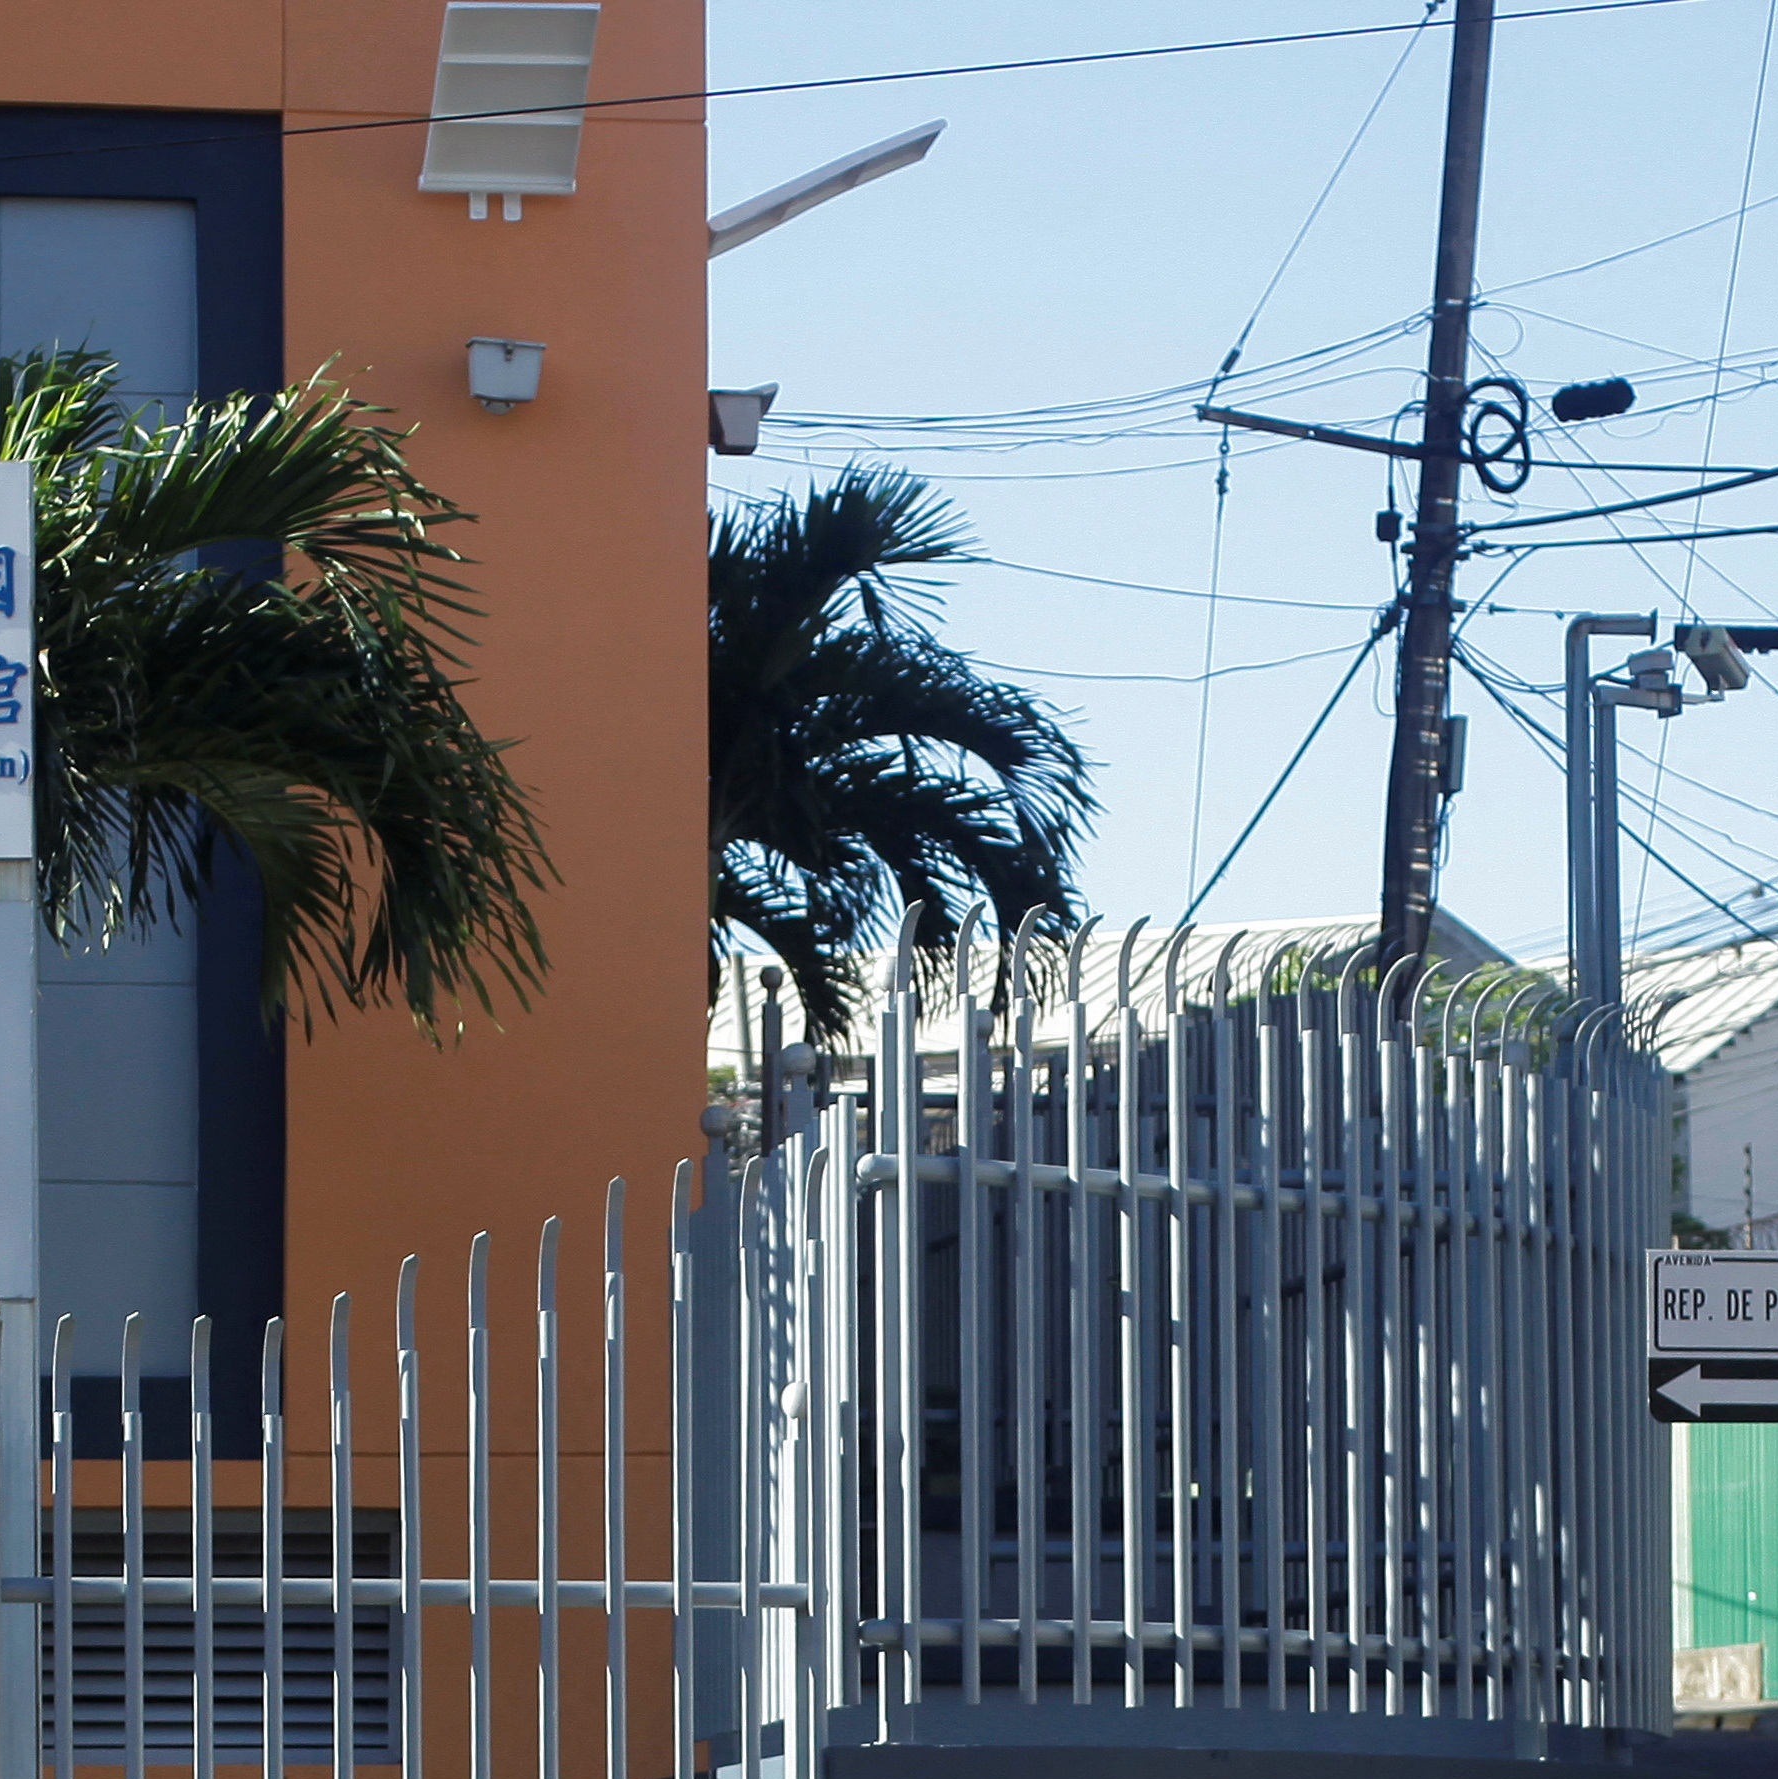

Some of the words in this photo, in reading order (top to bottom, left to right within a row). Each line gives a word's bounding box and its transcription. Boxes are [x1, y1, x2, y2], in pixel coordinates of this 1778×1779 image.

[1664, 1254, 1712, 1266] AVENIDA
[1664, 1288, 1713, 1320] REP.
[1727, 1289, 1754, 1321] DE
